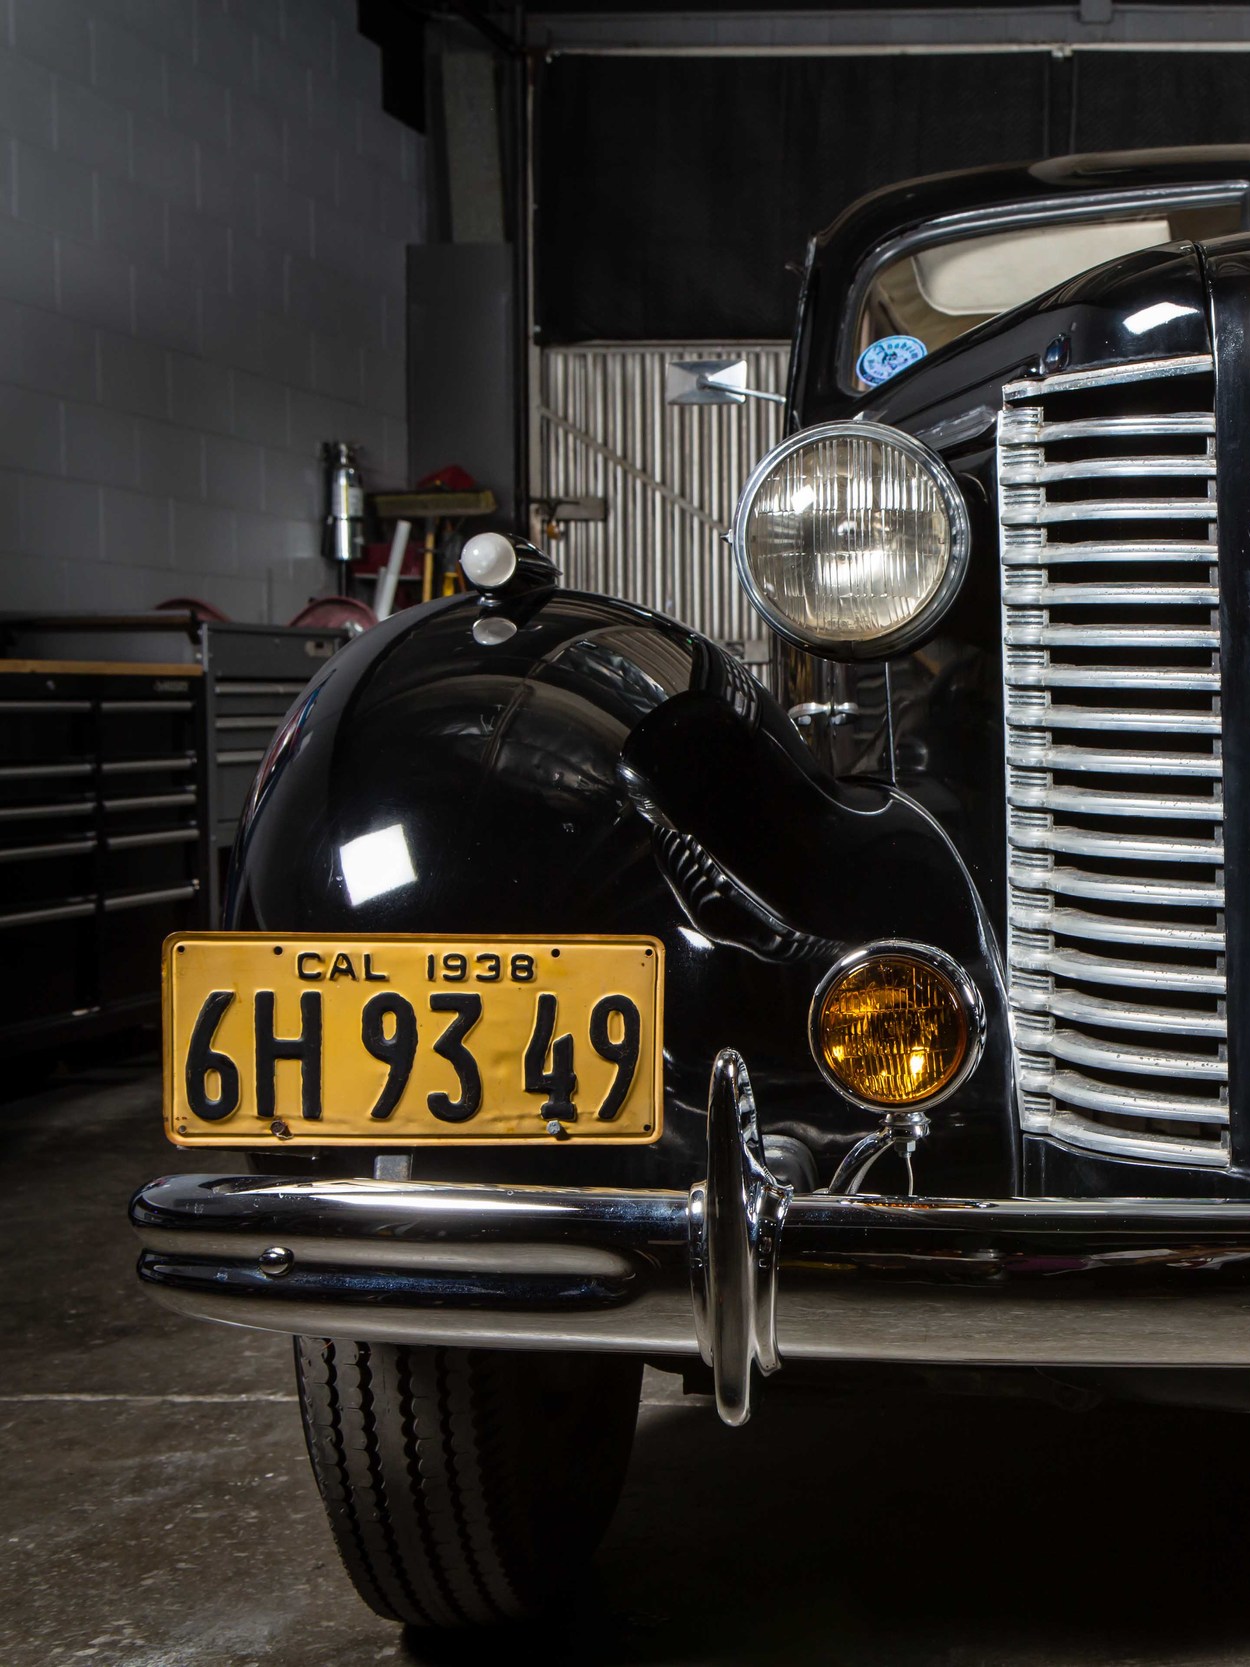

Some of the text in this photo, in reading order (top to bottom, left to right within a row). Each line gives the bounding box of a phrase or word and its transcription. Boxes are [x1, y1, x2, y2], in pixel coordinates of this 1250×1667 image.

[296, 952, 536, 983] CAL 1938
[185, 990, 642, 1123] 6H 93 49
